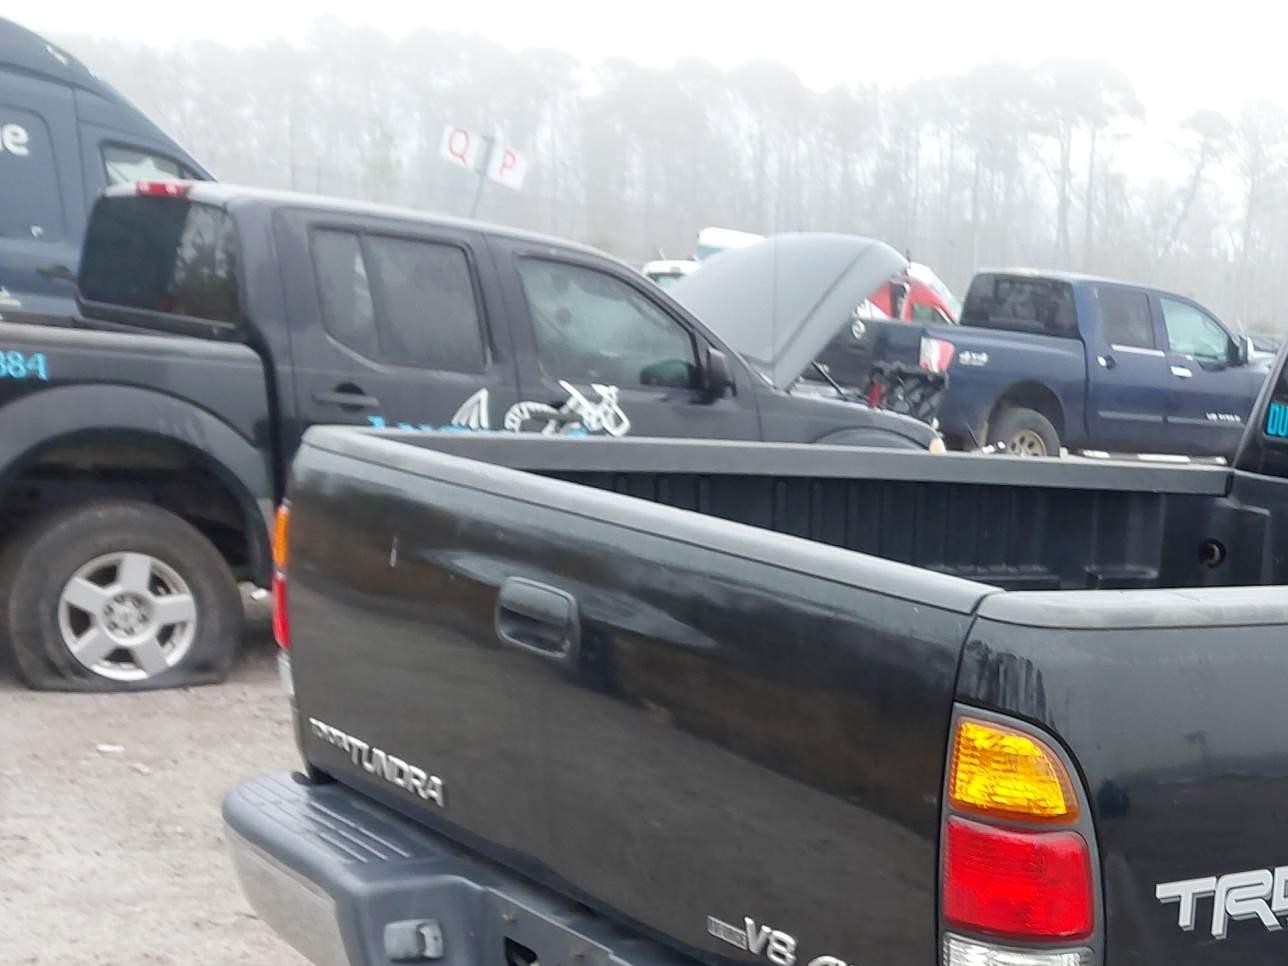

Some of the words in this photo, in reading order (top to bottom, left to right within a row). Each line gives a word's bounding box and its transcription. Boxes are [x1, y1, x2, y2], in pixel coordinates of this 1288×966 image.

[0, 124, 29, 156] e
[447, 127, 470, 166] Q
[499, 148, 517, 176] P
[348, 735, 445, 808] TUNDRA
